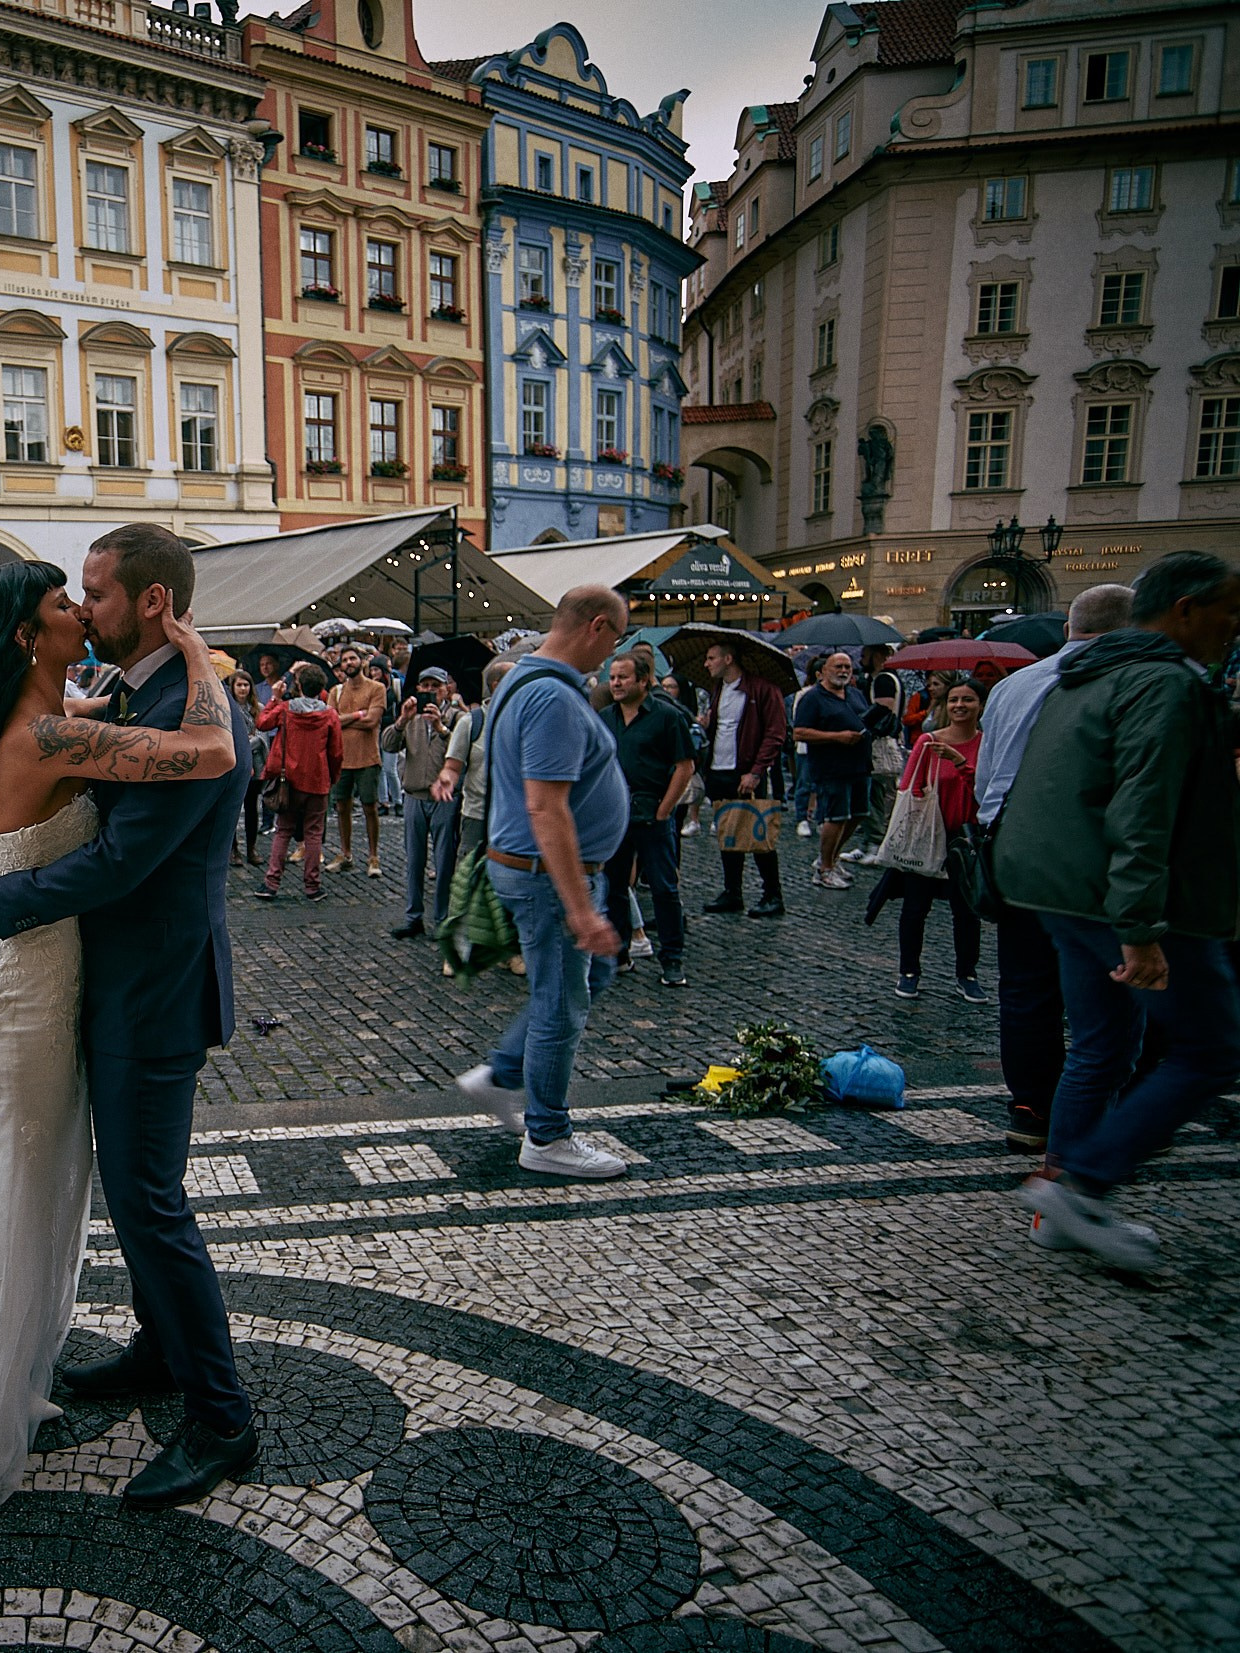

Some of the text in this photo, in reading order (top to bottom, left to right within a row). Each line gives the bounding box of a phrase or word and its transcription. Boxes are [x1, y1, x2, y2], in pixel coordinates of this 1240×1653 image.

[4, 283, 130, 308] illusion art museum prague
[886, 551, 936, 563] ERPET
[963, 588, 1009, 601] ERPET
[893, 854, 924, 867] MADRID
